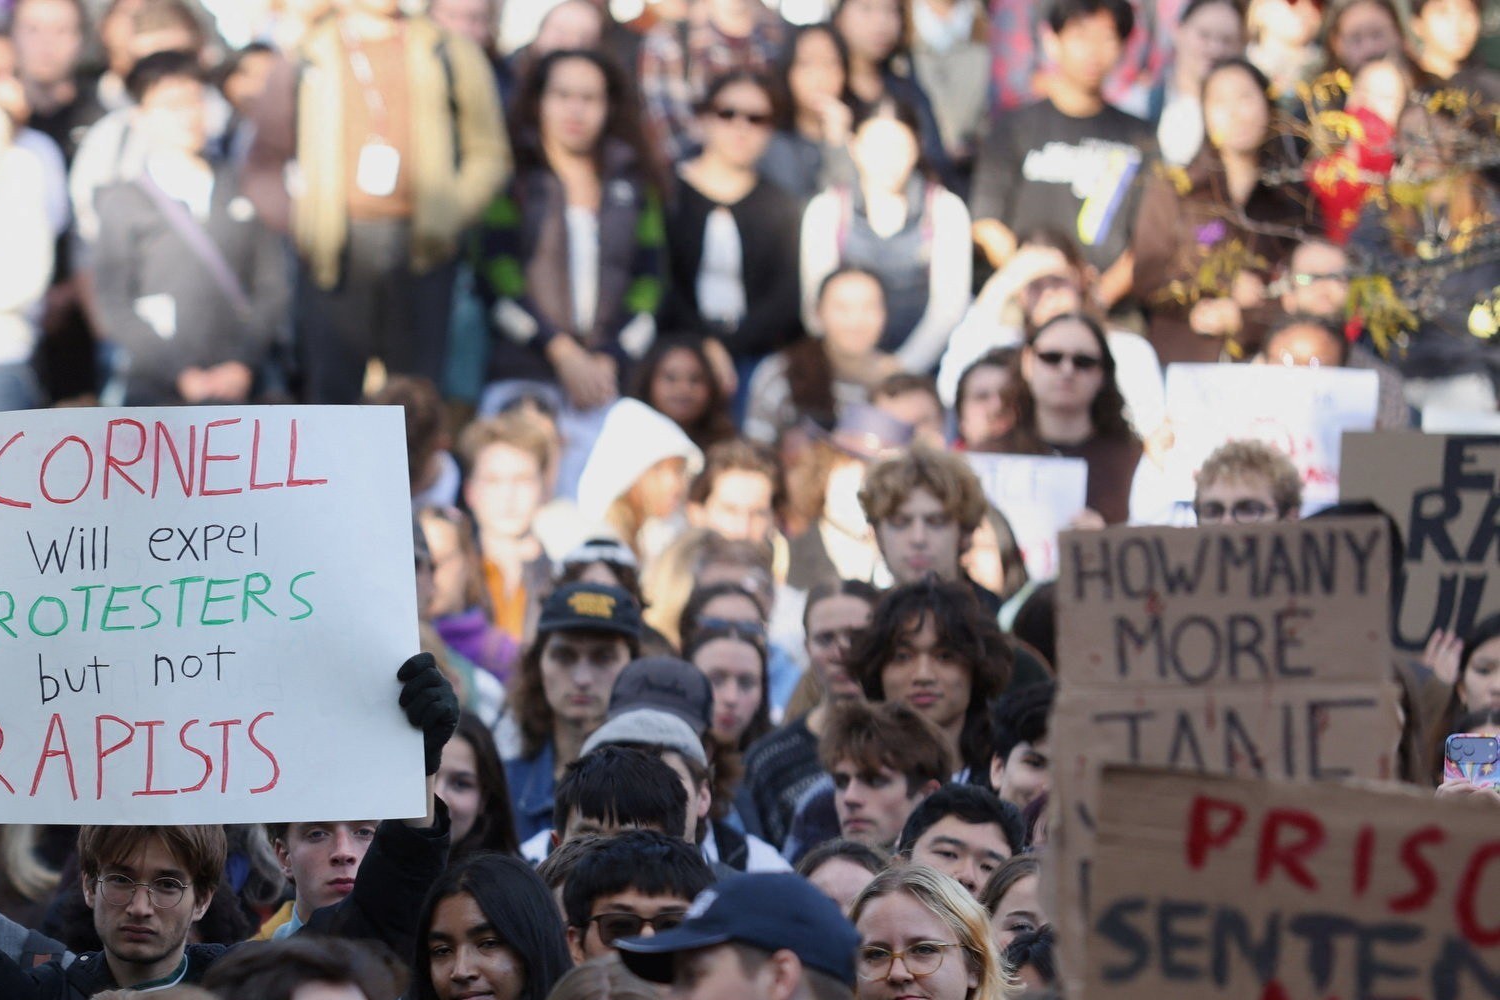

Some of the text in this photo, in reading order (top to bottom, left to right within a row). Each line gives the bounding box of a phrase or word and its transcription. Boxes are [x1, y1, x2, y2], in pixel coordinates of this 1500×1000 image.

[147, 522, 260, 562] expel
[1071, 527, 1384, 600] HOW MANY
[38, 645, 236, 705] but not
[1112, 608, 1315, 686] MORE
